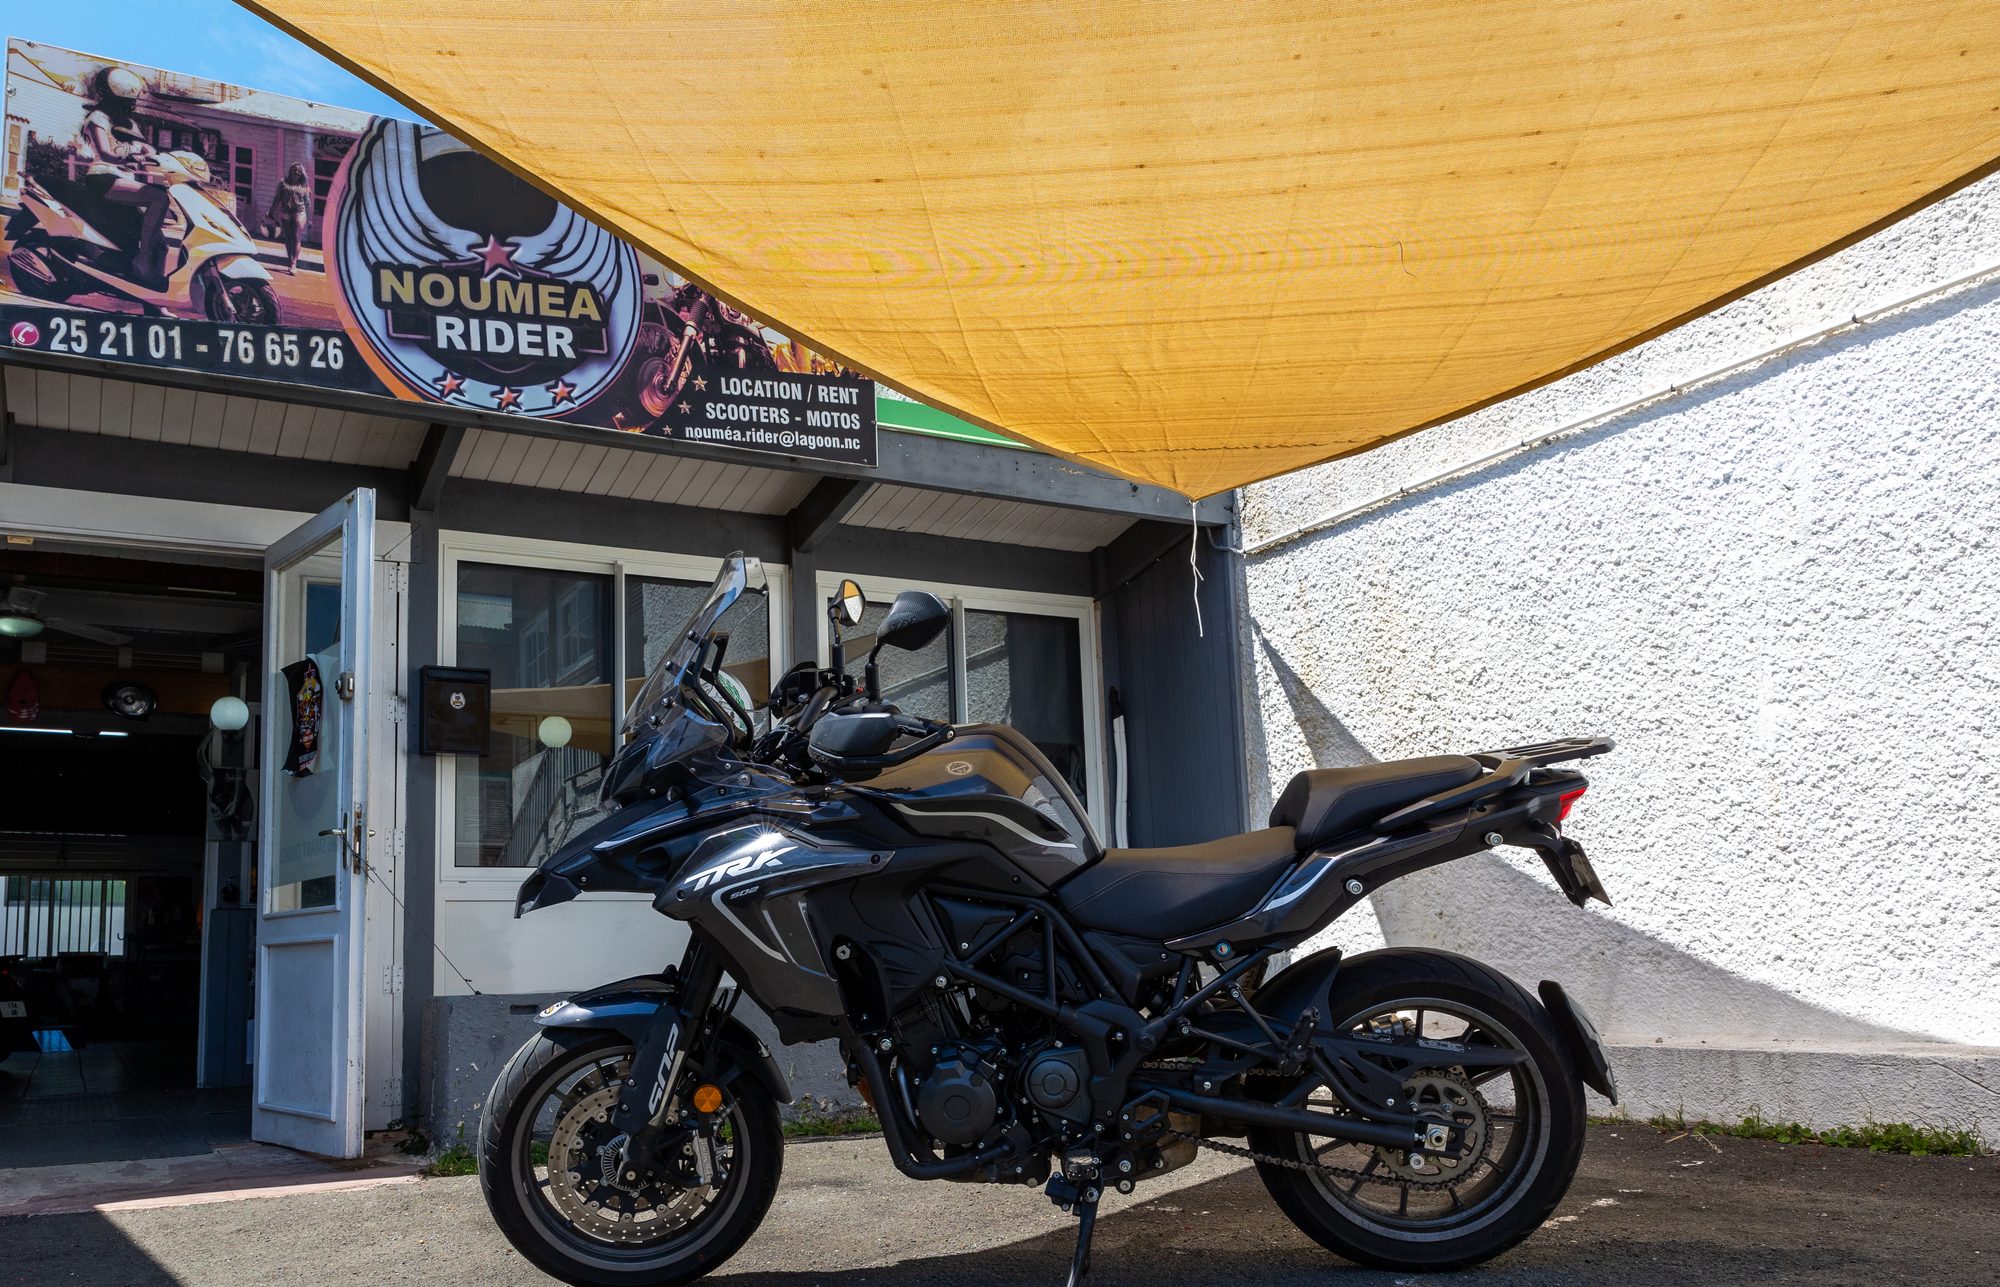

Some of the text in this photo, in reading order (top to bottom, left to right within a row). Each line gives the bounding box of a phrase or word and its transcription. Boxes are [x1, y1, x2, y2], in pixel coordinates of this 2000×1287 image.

[380, 268, 602, 322] NOUMEA
[50, 316, 344, 370] 25 21 01 - 76 65 26
[435, 315, 577, 359] RIDER
[720, 376, 859, 405] LOCATION / RENT
[685, 426, 861, 450] nouméa.rider@lagoon.nc
[705, 402, 790, 425] SCOOTERS
[806, 410, 861, 430] MOTOS
[683, 845, 799, 892] TRK
